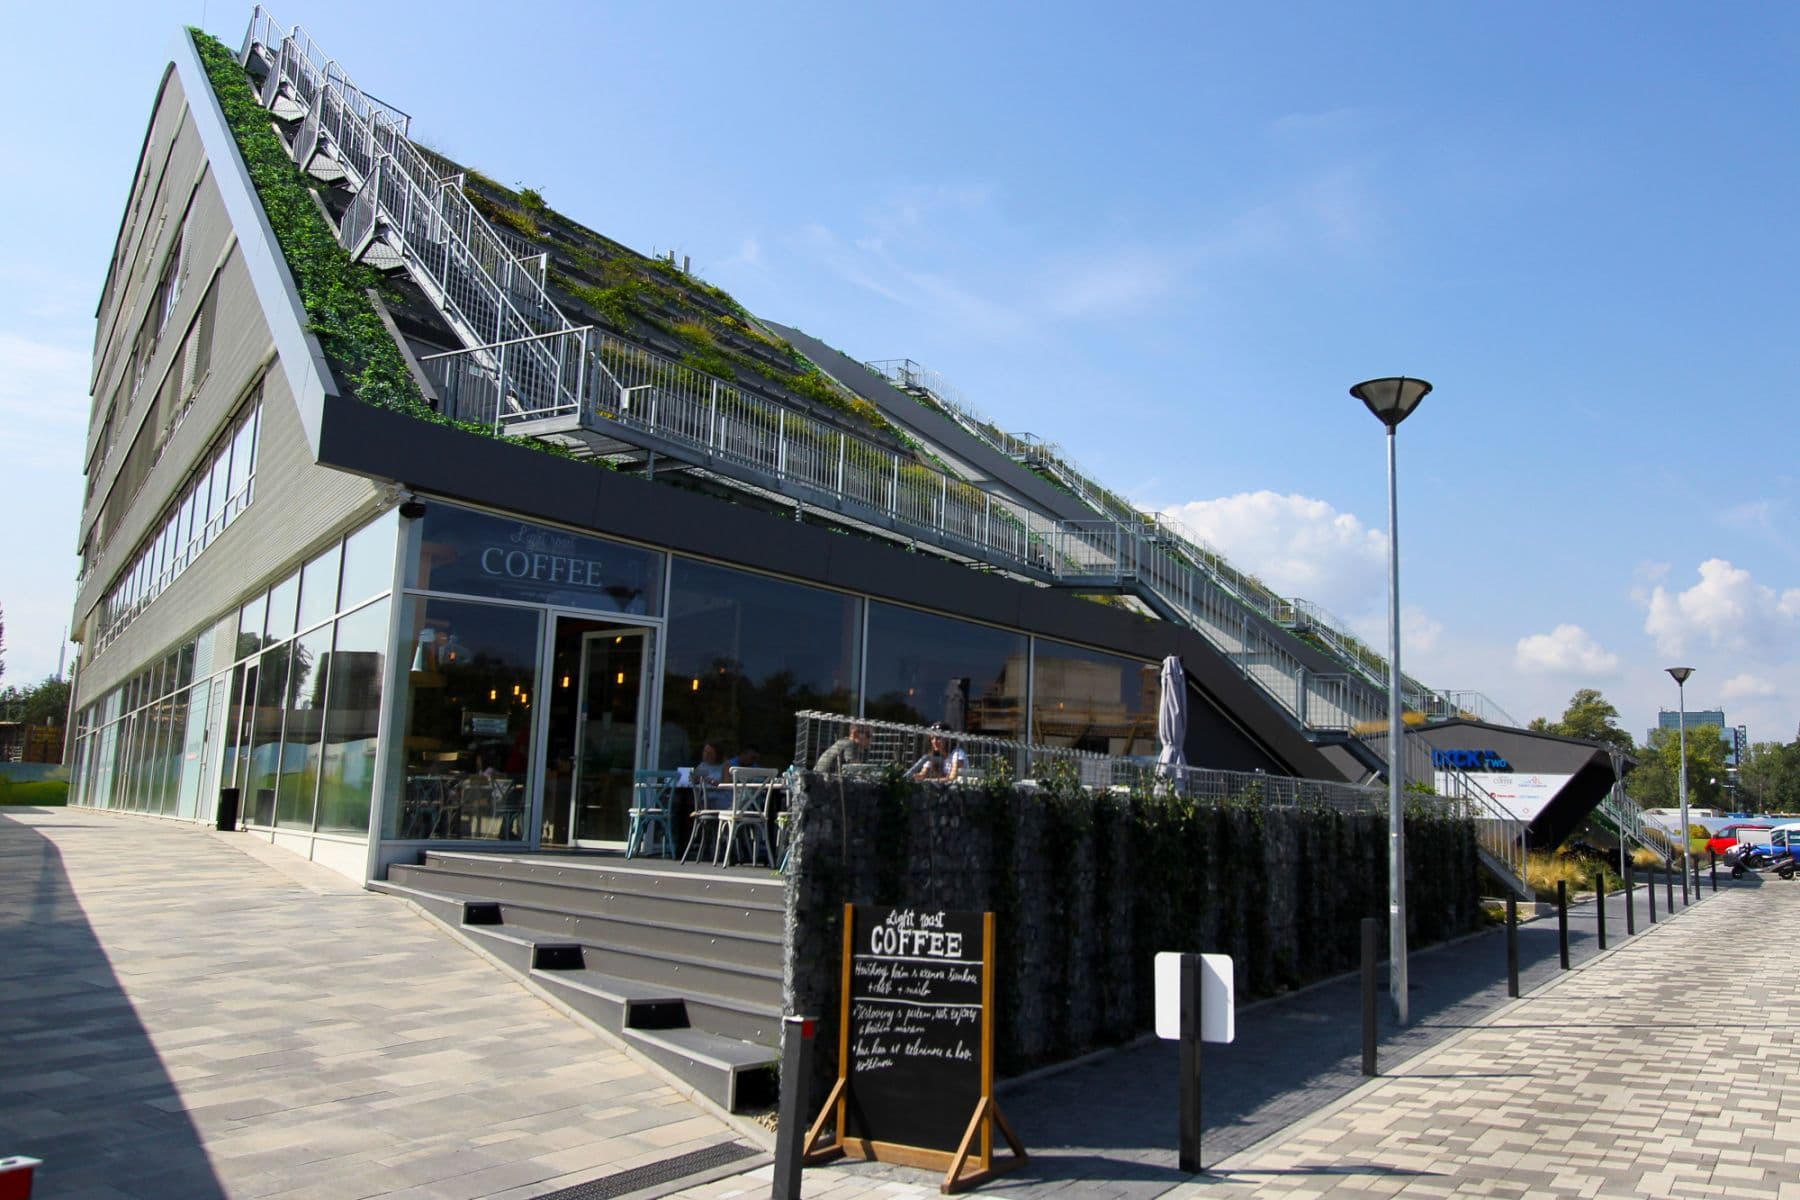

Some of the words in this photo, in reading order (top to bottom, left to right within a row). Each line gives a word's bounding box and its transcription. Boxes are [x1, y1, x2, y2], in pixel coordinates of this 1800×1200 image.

[481, 546, 602, 587] COFFEE
[1485, 758, 1507, 768] TWO
[886, 908, 914, 932] Light
[920, 910, 946, 928] roast
[871, 925, 962, 957] COFFEE
